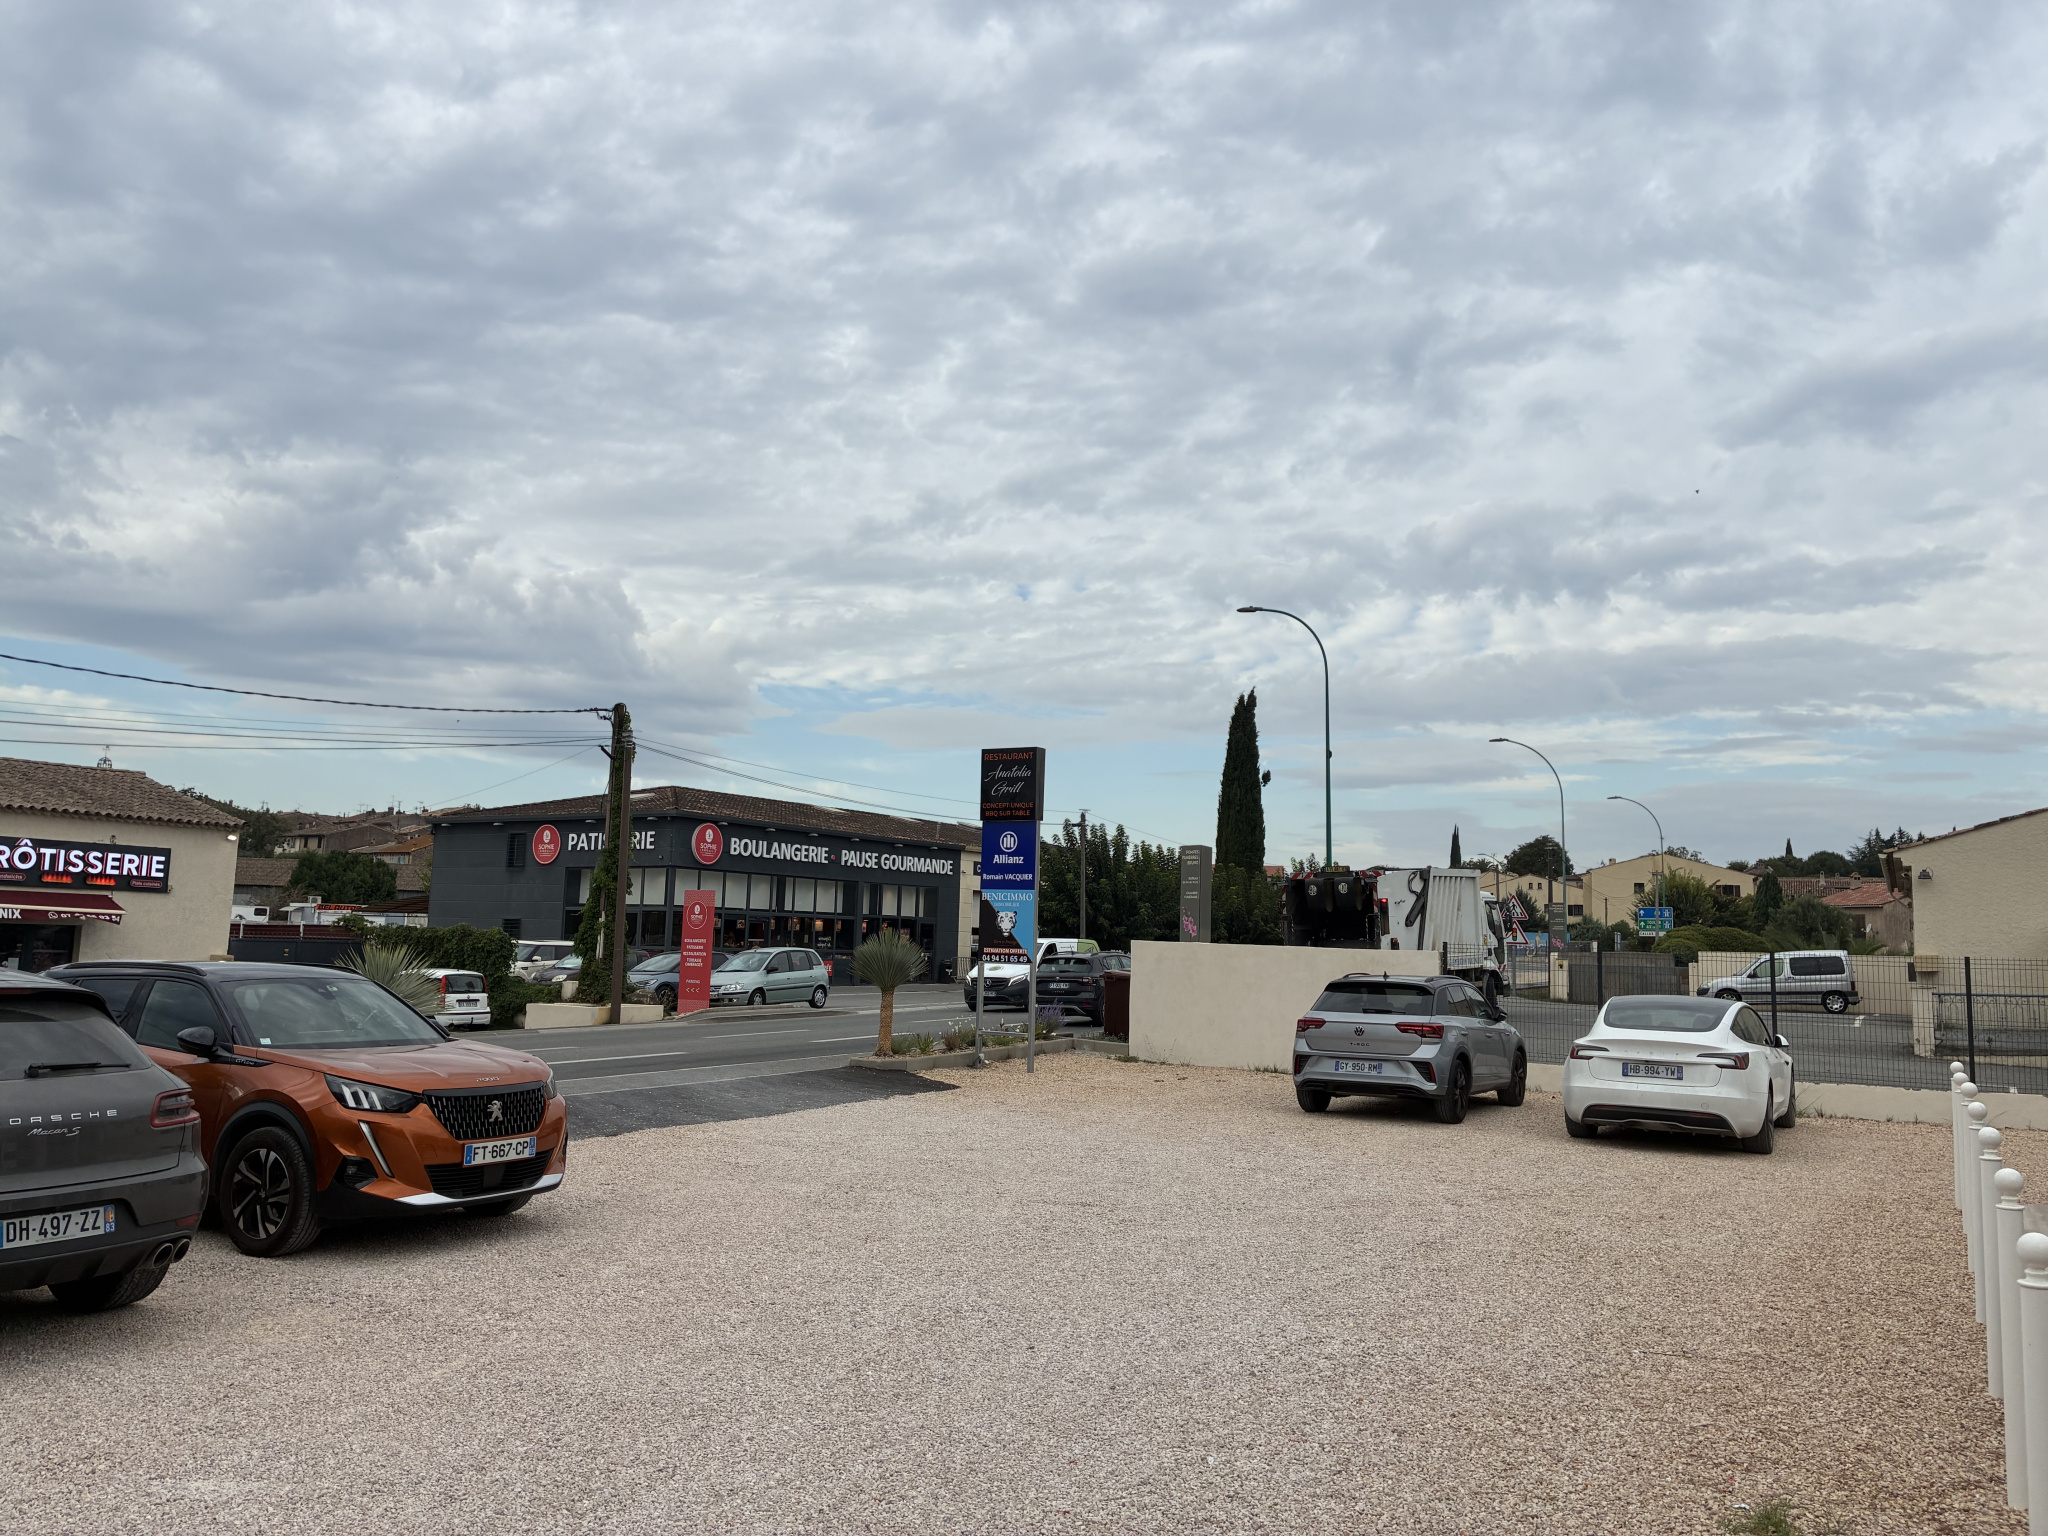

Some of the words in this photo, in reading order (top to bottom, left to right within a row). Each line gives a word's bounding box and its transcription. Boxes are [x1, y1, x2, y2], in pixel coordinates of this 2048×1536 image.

[984, 752, 1034, 761] RESTAURANT
[984, 764, 1032, 782] Anatolia
[991, 781, 1025, 797] Grill
[1010, 801, 1034, 809] UNIQUE
[985, 810, 999, 818] BBQ
[0, 838, 166, 878] RÔTISSERIE
[730, 837, 829, 864] BOULANGERIE
[841, 849, 879, 869] PAUSE
[881, 853, 954, 876] GOURMANDE
[992, 854, 1025, 864] Allianz
[1004, 873, 1033, 882] VACQUIER
[981, 892, 1034, 902] BENICIMMO
[982, 954, 990, 962] 04
[1340, 1061, 1378, 1072] GY-950-RM
[1629, 1064, 1676, 1077] HB-994-YW
[27, 1127, 68, 1137] Macan
[65, 1126, 82, 1137] S
[472, 1140, 530, 1162] FT-667-CP
[6, 1209, 101, 1243] DH-497-ZZ
[105, 1222, 116, 1232] 83
